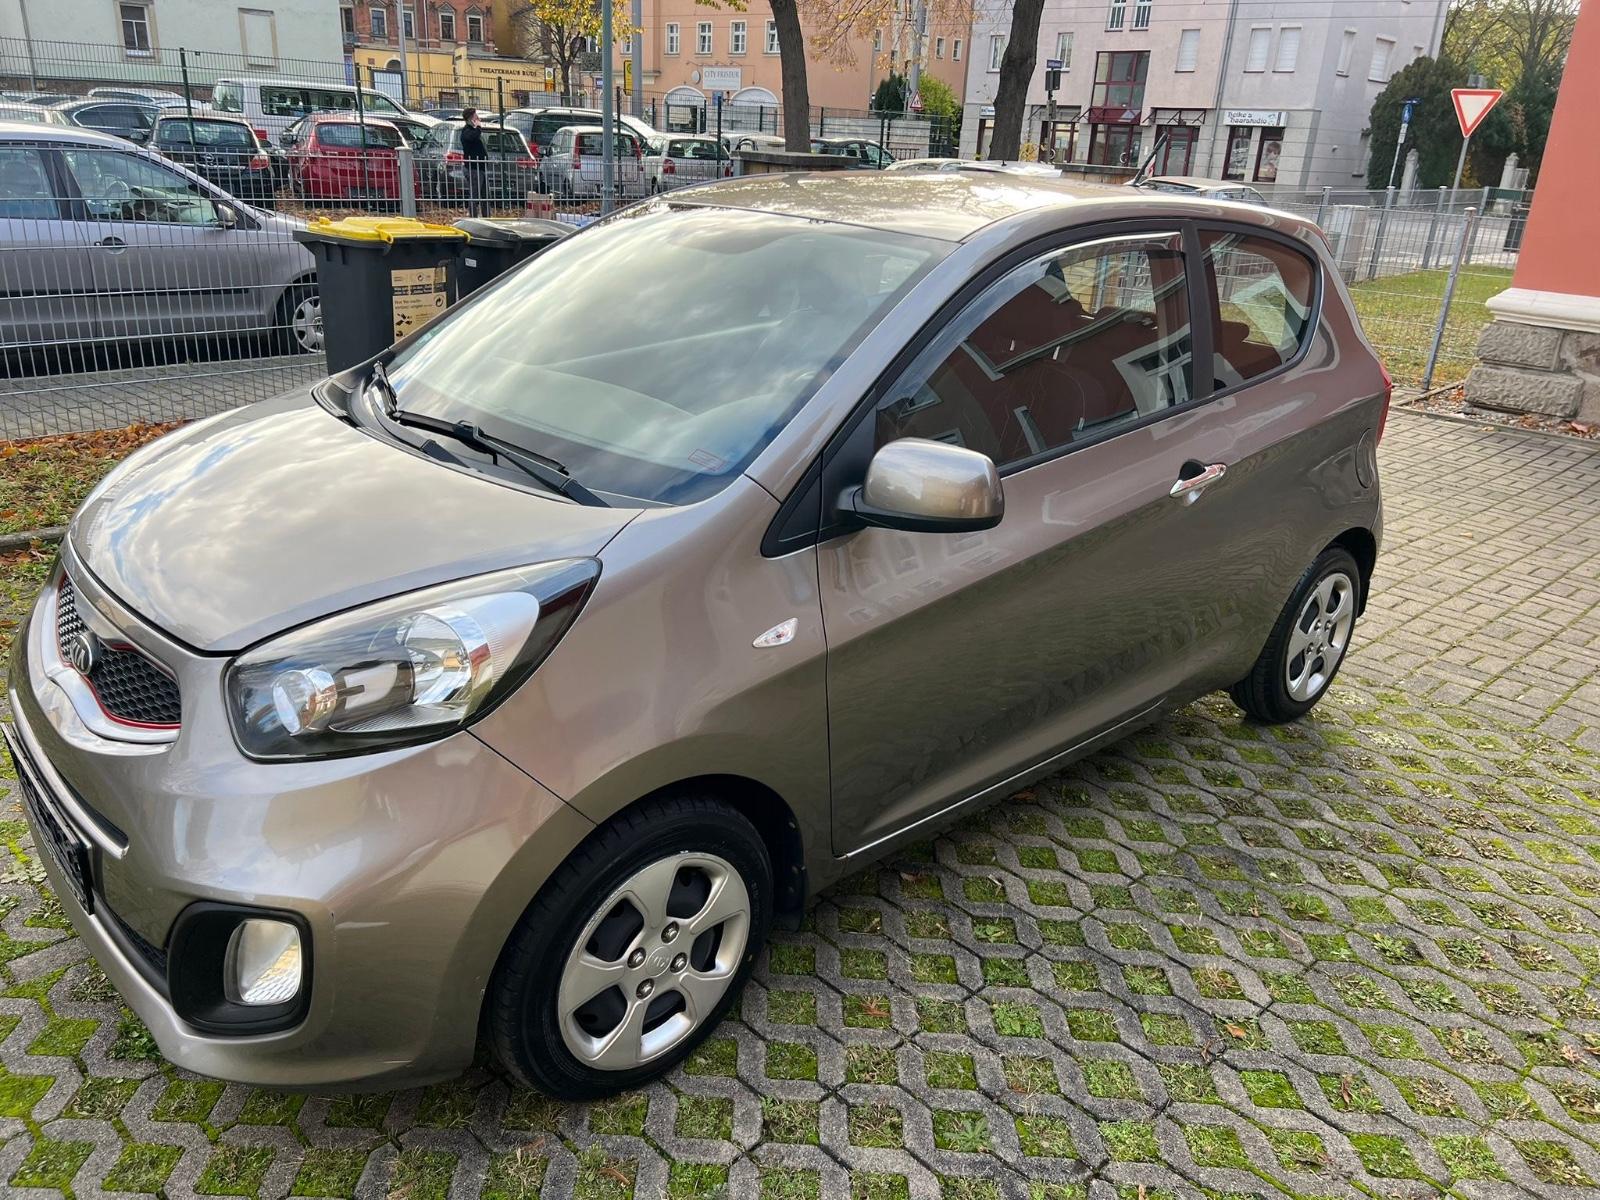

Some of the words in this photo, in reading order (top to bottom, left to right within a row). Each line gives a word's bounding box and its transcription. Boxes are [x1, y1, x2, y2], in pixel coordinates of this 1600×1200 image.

[479, 67, 521, 76] THEATERHAUS
[704, 70, 717, 79] CITY
[717, 70, 740, 79] FRISEUR
